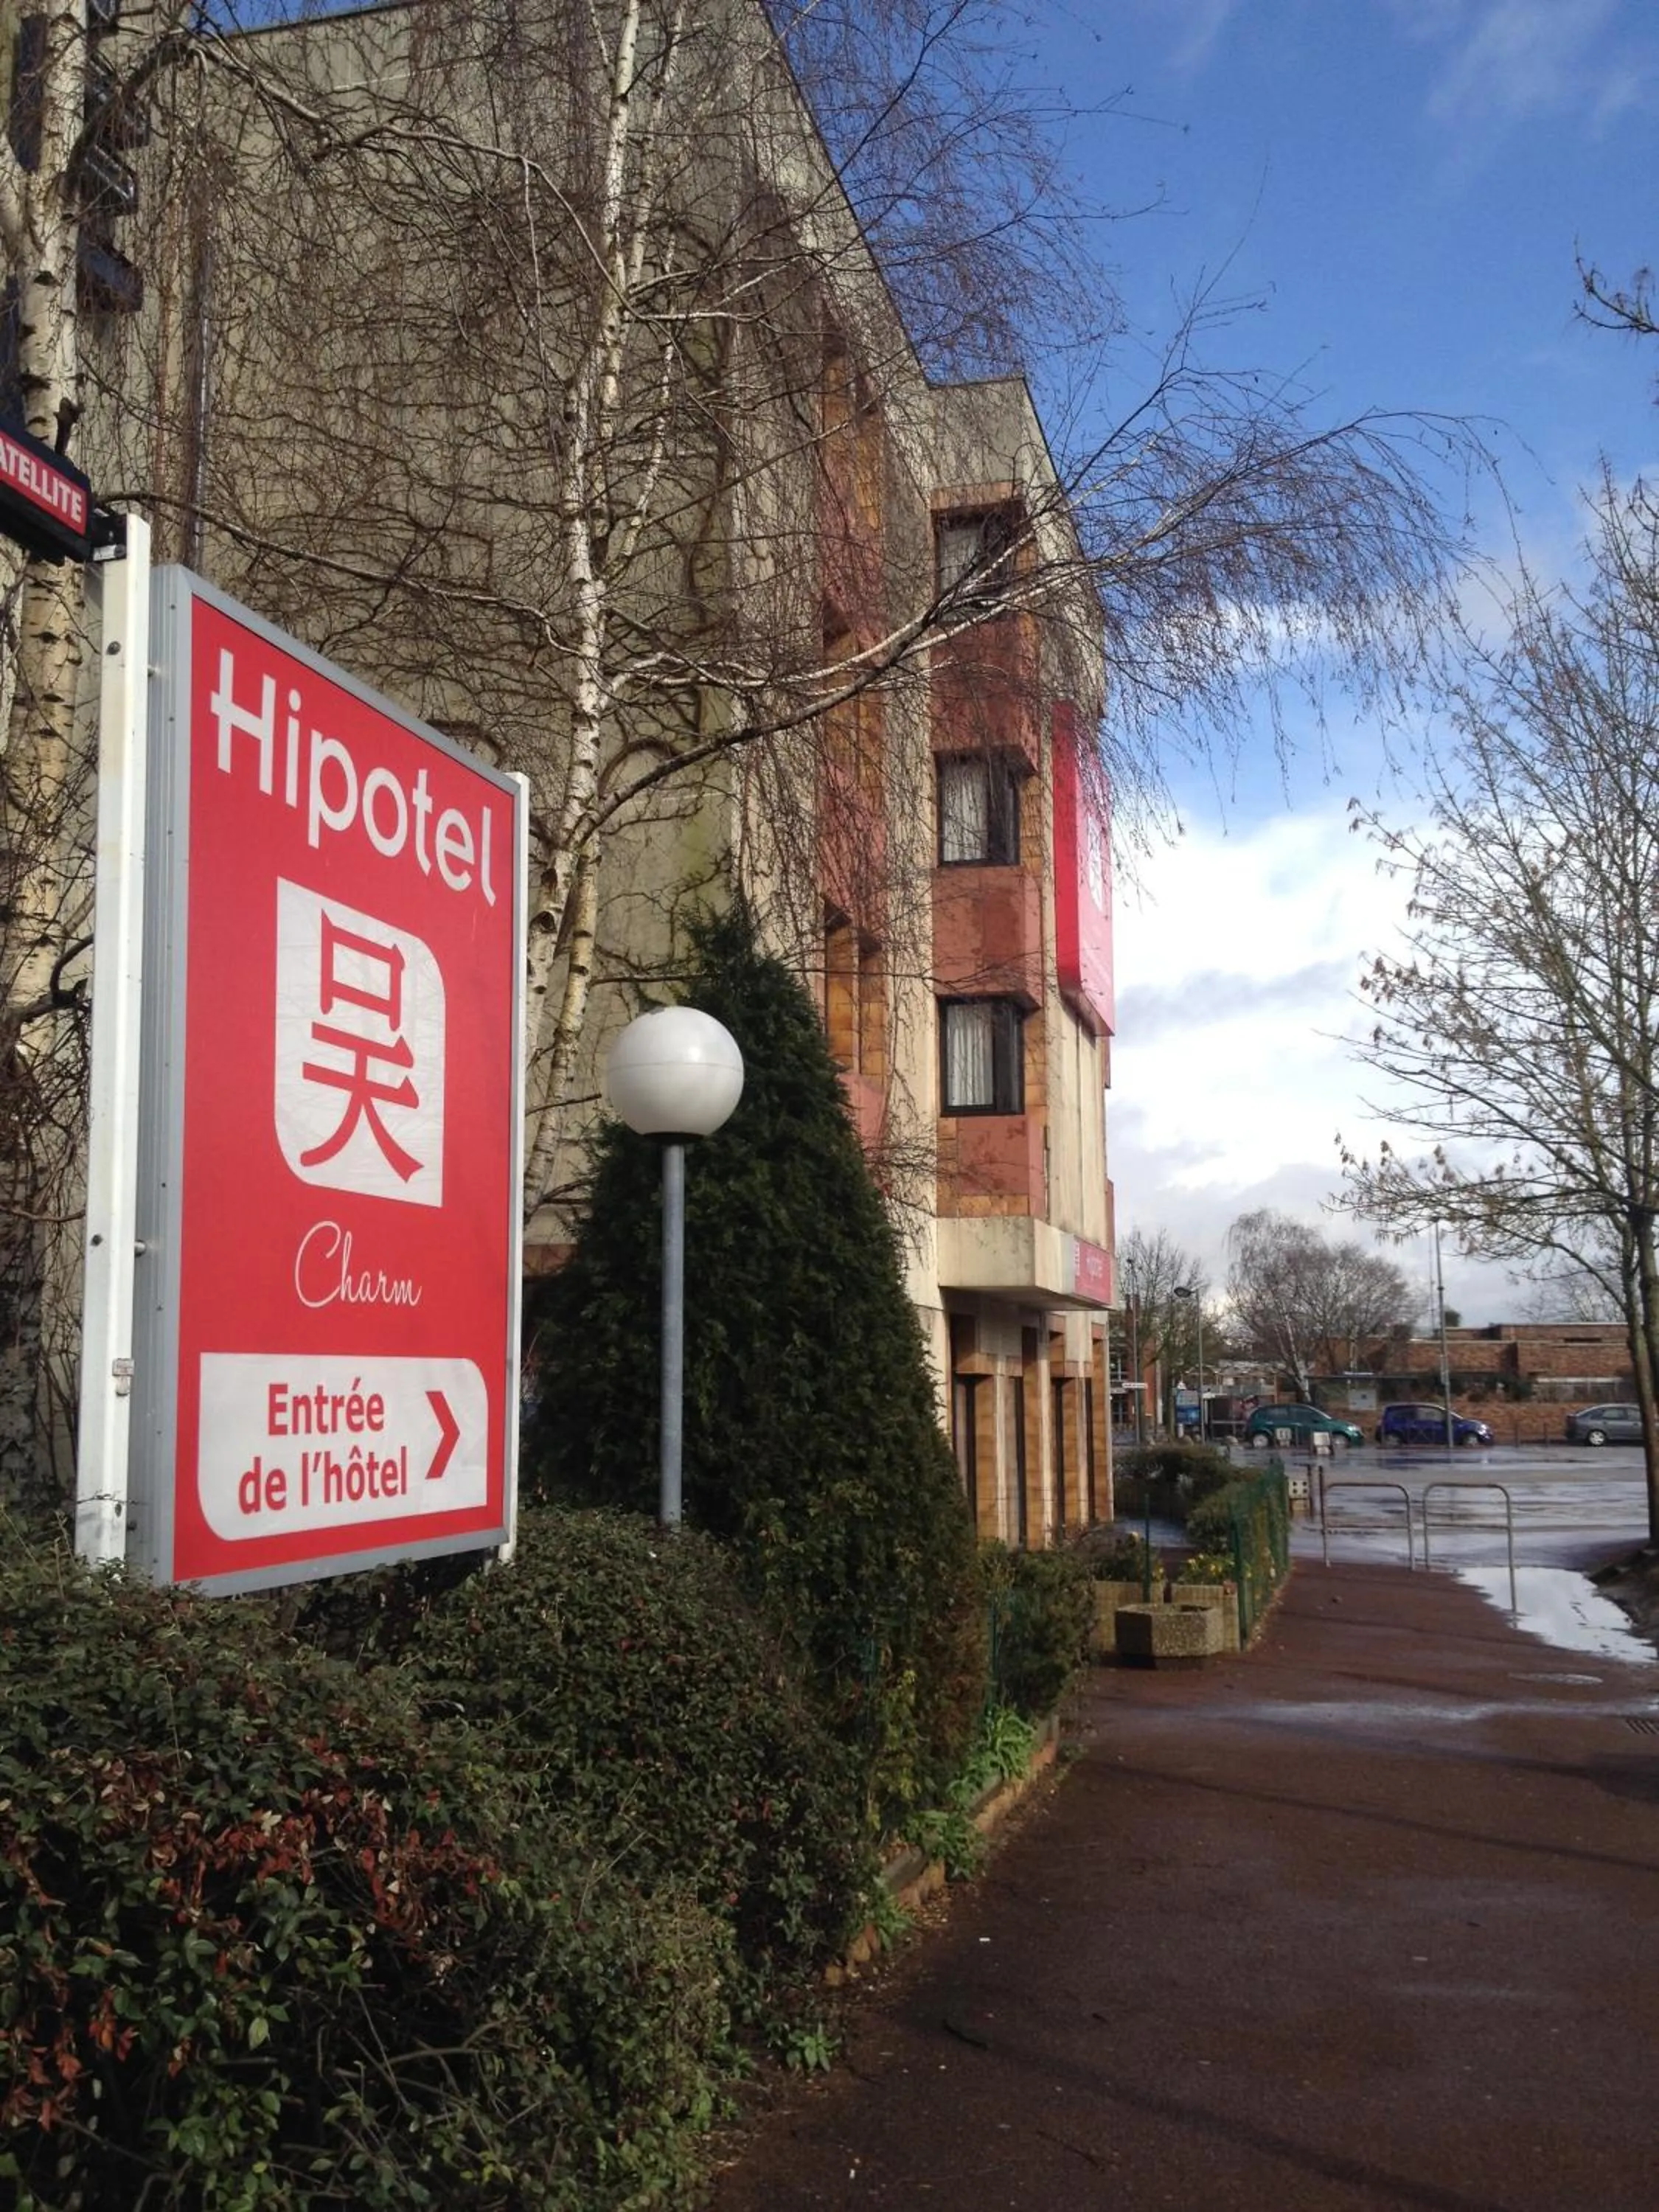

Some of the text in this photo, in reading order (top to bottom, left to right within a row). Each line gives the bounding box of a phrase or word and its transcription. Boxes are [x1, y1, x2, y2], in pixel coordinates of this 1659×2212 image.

[211, 648, 496, 907] Hipotel
[295, 1220, 422, 1309] Charm
[268, 1377, 385, 1436] Entrée
[238, 1445, 408, 1515] de l'hôtel
